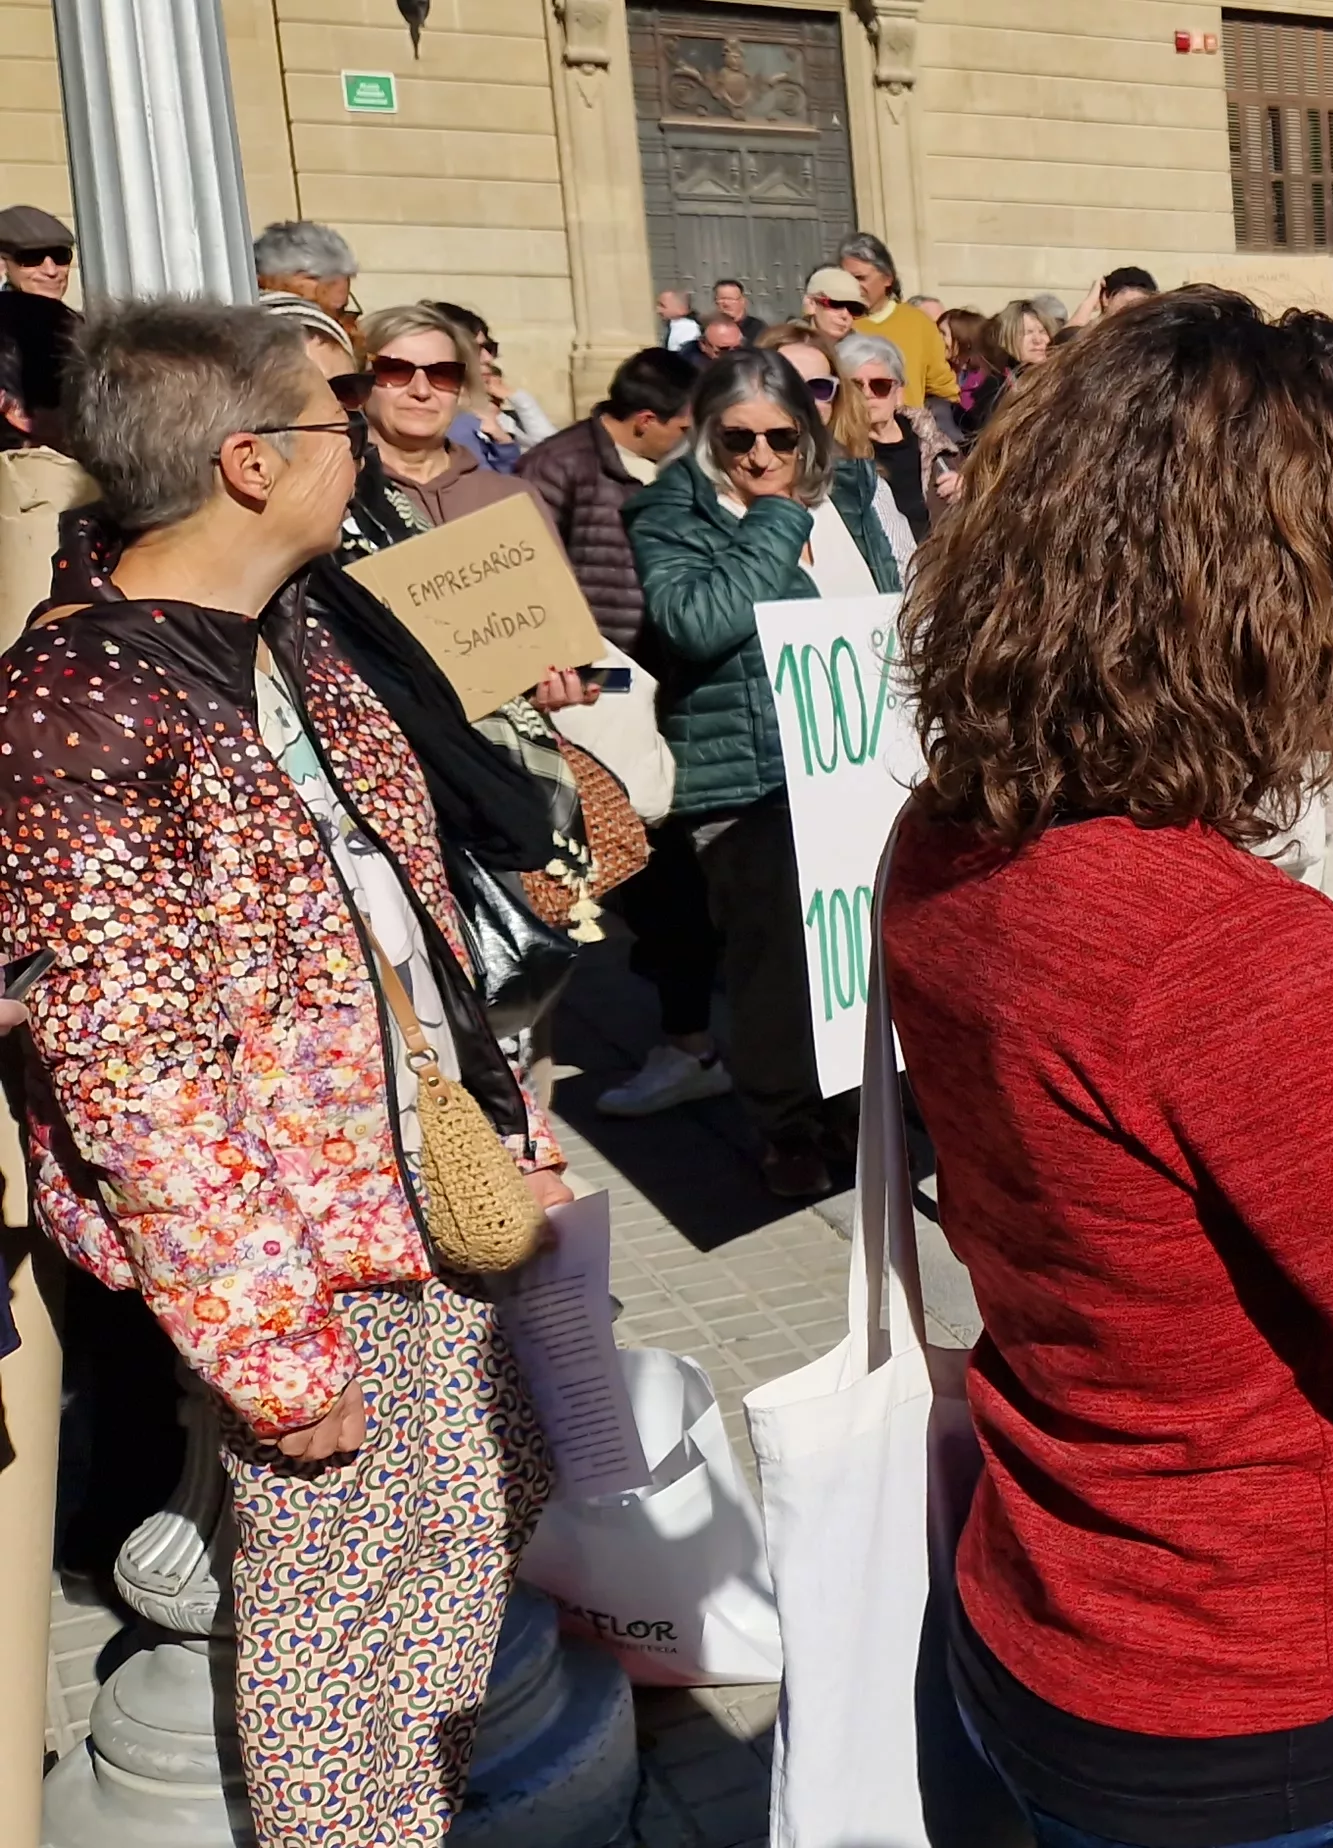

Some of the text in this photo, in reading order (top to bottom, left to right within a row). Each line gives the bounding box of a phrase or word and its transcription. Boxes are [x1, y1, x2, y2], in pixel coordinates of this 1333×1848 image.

[407, 540, 536, 607] EMPRESARIOS
[453, 604, 547, 656] SANIDAD
[775, 626, 898, 777] 100%
